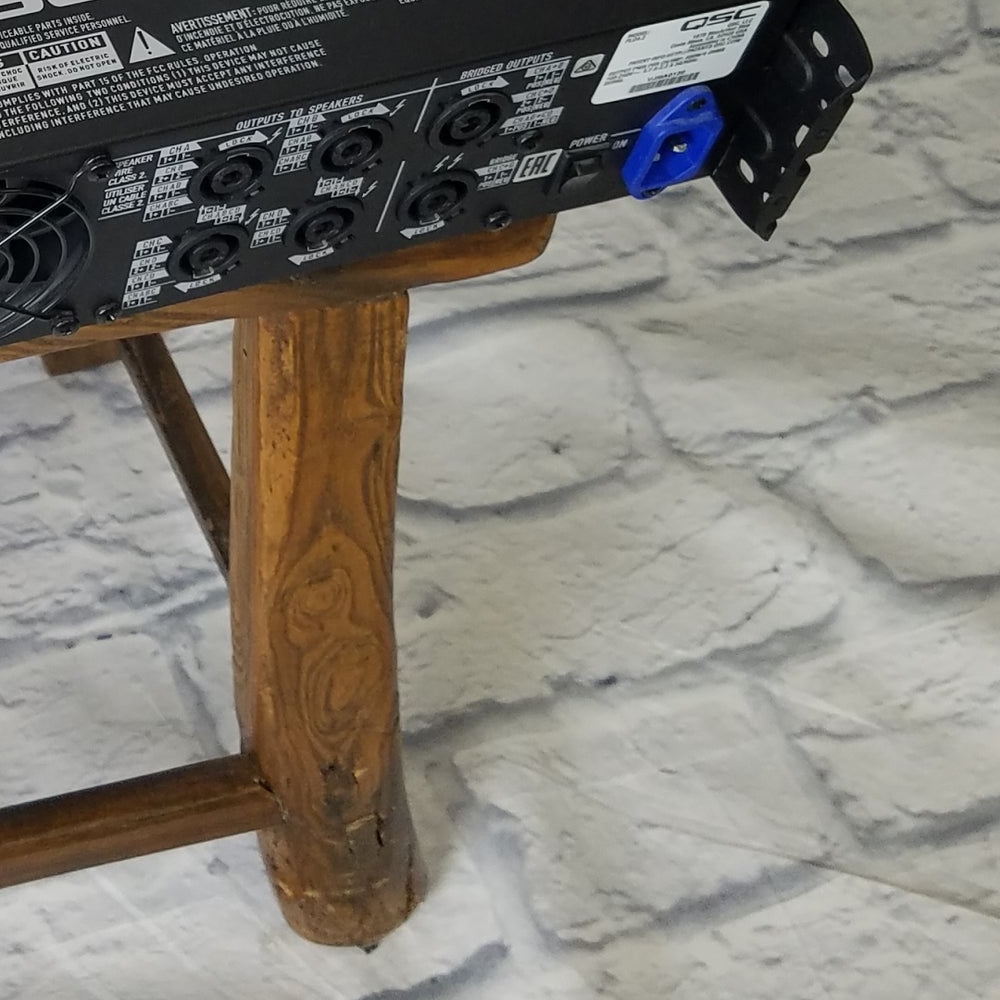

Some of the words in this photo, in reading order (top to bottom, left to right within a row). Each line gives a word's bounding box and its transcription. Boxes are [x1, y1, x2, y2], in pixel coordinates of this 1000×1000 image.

[34, 18, 62, 31] PARTS
[680, 5, 761, 31] QSC
[0, 33, 43, 49] QUALIFIED
[43, 25, 79, 40] SERVICE
[27, 36, 101, 60] CAUTION
[41, 86, 68, 98] WITH
[71, 79, 96, 91] PART
[98, 76, 110, 85] 15
[110, 73, 123, 83] OF
[125, 68, 145, 79] THE
[146, 64, 166, 75] FCC
[203, 44, 257, 61] OPERATION
[505, 51, 553, 70] OUTPUTS
[3, 105, 24, 117] THE
[24, 92, 83, 111] FOLLOWING
[86, 87, 108, 98] TWO
[110, 73, 170, 92] CONDITIONS
[170, 68, 186, 79] (1)
[187, 64, 211, 75] THIS
[211, 56, 247, 70] DEVICE
[247, 51, 267, 62] MAY
[268, 46, 288, 57] NOT
[289, 39, 321, 52] CAUSE
[66, 102, 86, 113] AND
[87, 96, 103, 108] (2)
[104, 92, 129, 104] THIS
[129, 84, 165, 98] DEVICE
[166, 77, 193, 90] MUST
[195, 69, 231, 84] ACCEPT
[234, 64, 252, 75] ANY
[253, 48, 326, 70] INTERFERENCE
[50, 103, 126, 126] INTERFERENCE
[126, 97, 151, 109] THAT
[152, 92, 173, 103] MAY
[174, 84, 207, 98] CAUSE
[207, 72, 263, 90] UNDESIRED
[236, 112, 284, 131] OUTPUTS
[290, 107, 304, 118] TO
[308, 94, 363, 115] SPEAKERS
[569, 133, 608, 148] POWER
